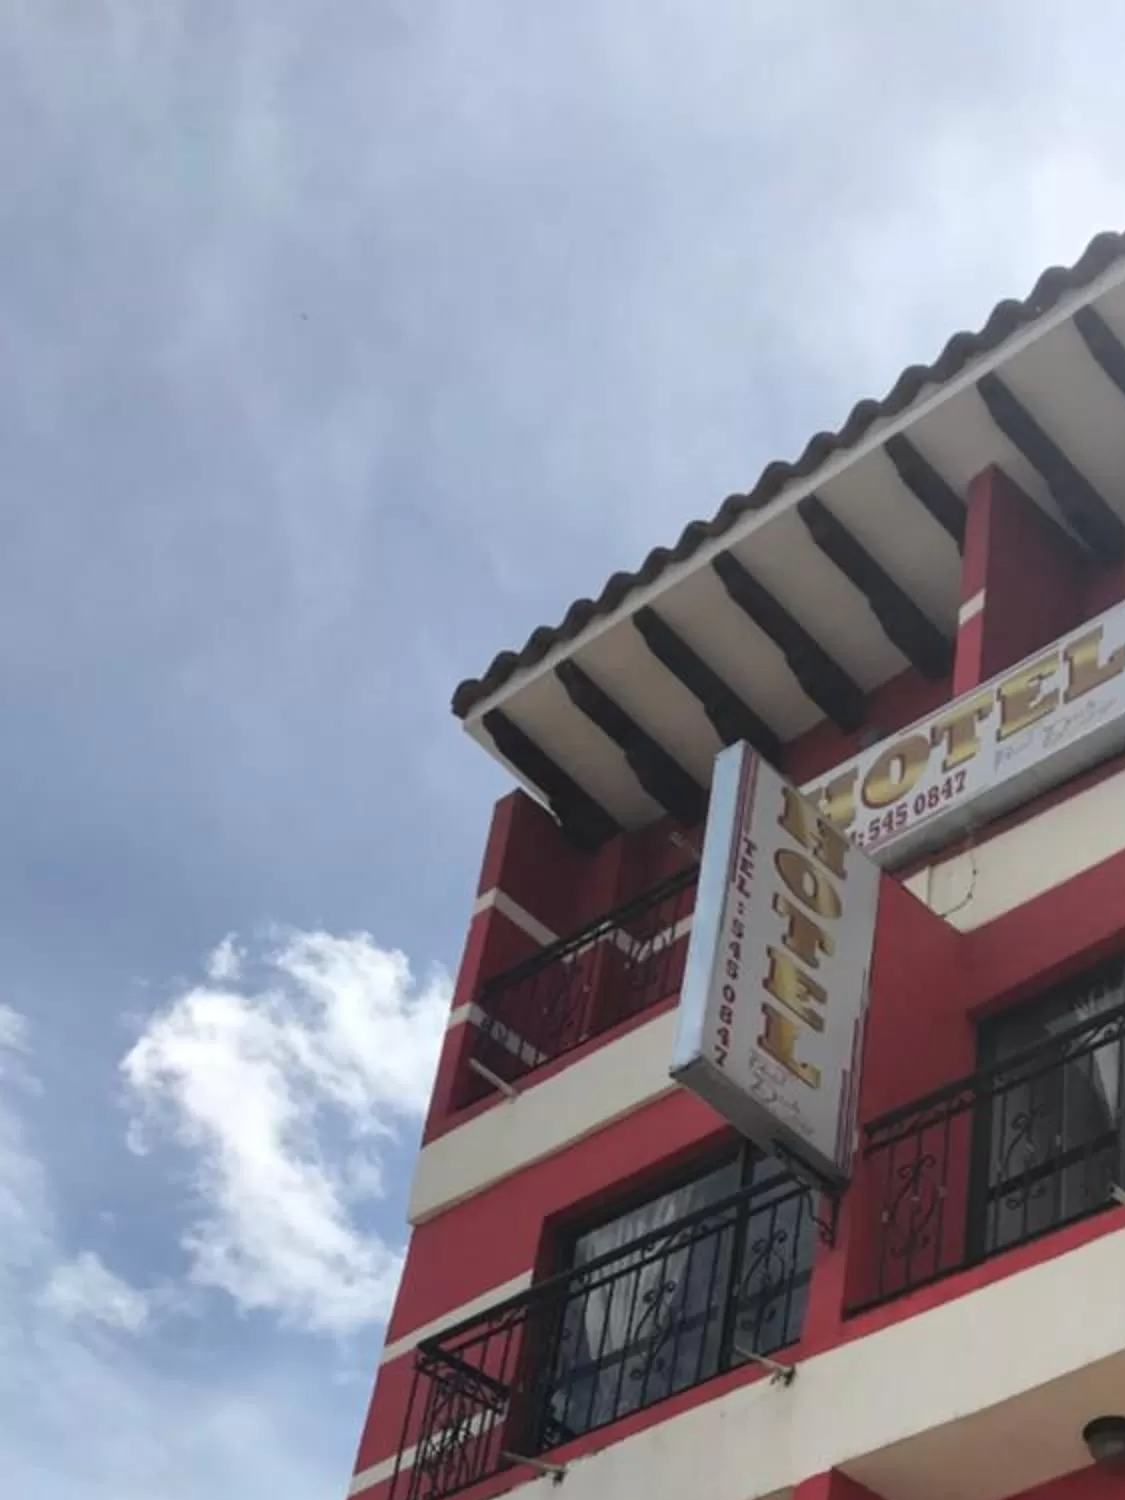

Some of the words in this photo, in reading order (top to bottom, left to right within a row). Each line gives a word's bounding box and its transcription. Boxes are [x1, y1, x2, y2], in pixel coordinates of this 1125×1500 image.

[868, 803, 908, 842] 545
[913, 770, 968, 817] 0847
[757, 787, 851, 1089] HOTEL
